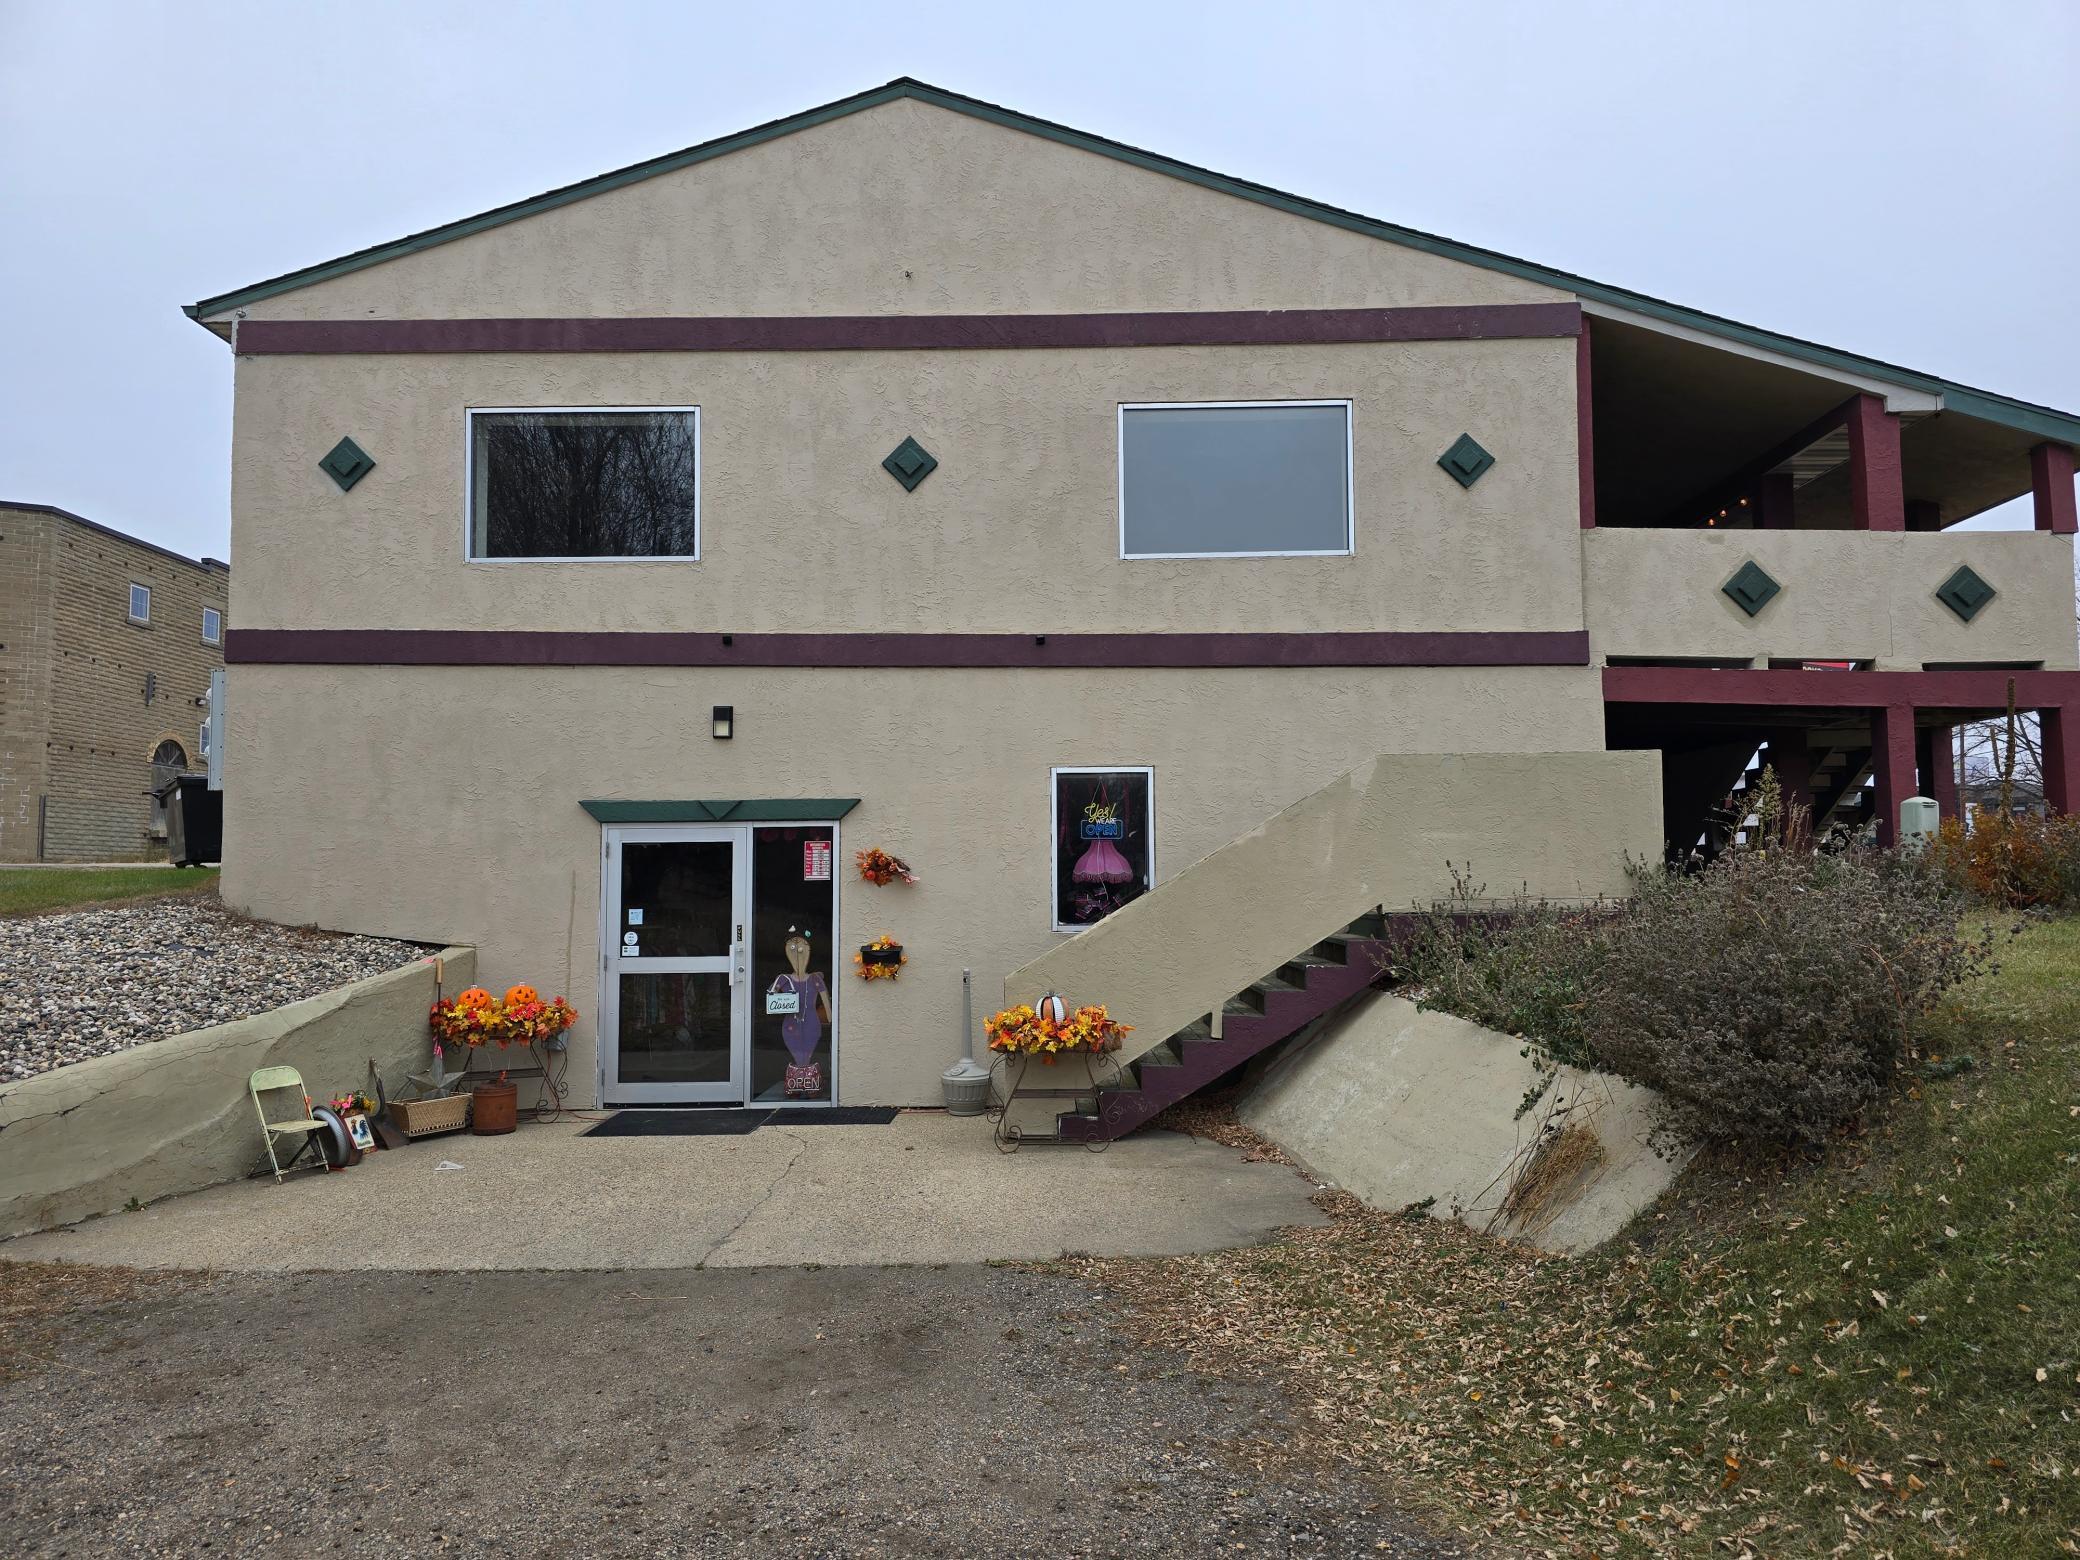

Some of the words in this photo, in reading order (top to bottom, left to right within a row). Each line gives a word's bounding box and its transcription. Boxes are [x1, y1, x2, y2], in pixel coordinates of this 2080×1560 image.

[1085, 824, 1118, 836] OPEN
[770, 1000, 796, 1010] Closed
[788, 1076, 820, 1089] OPEN
